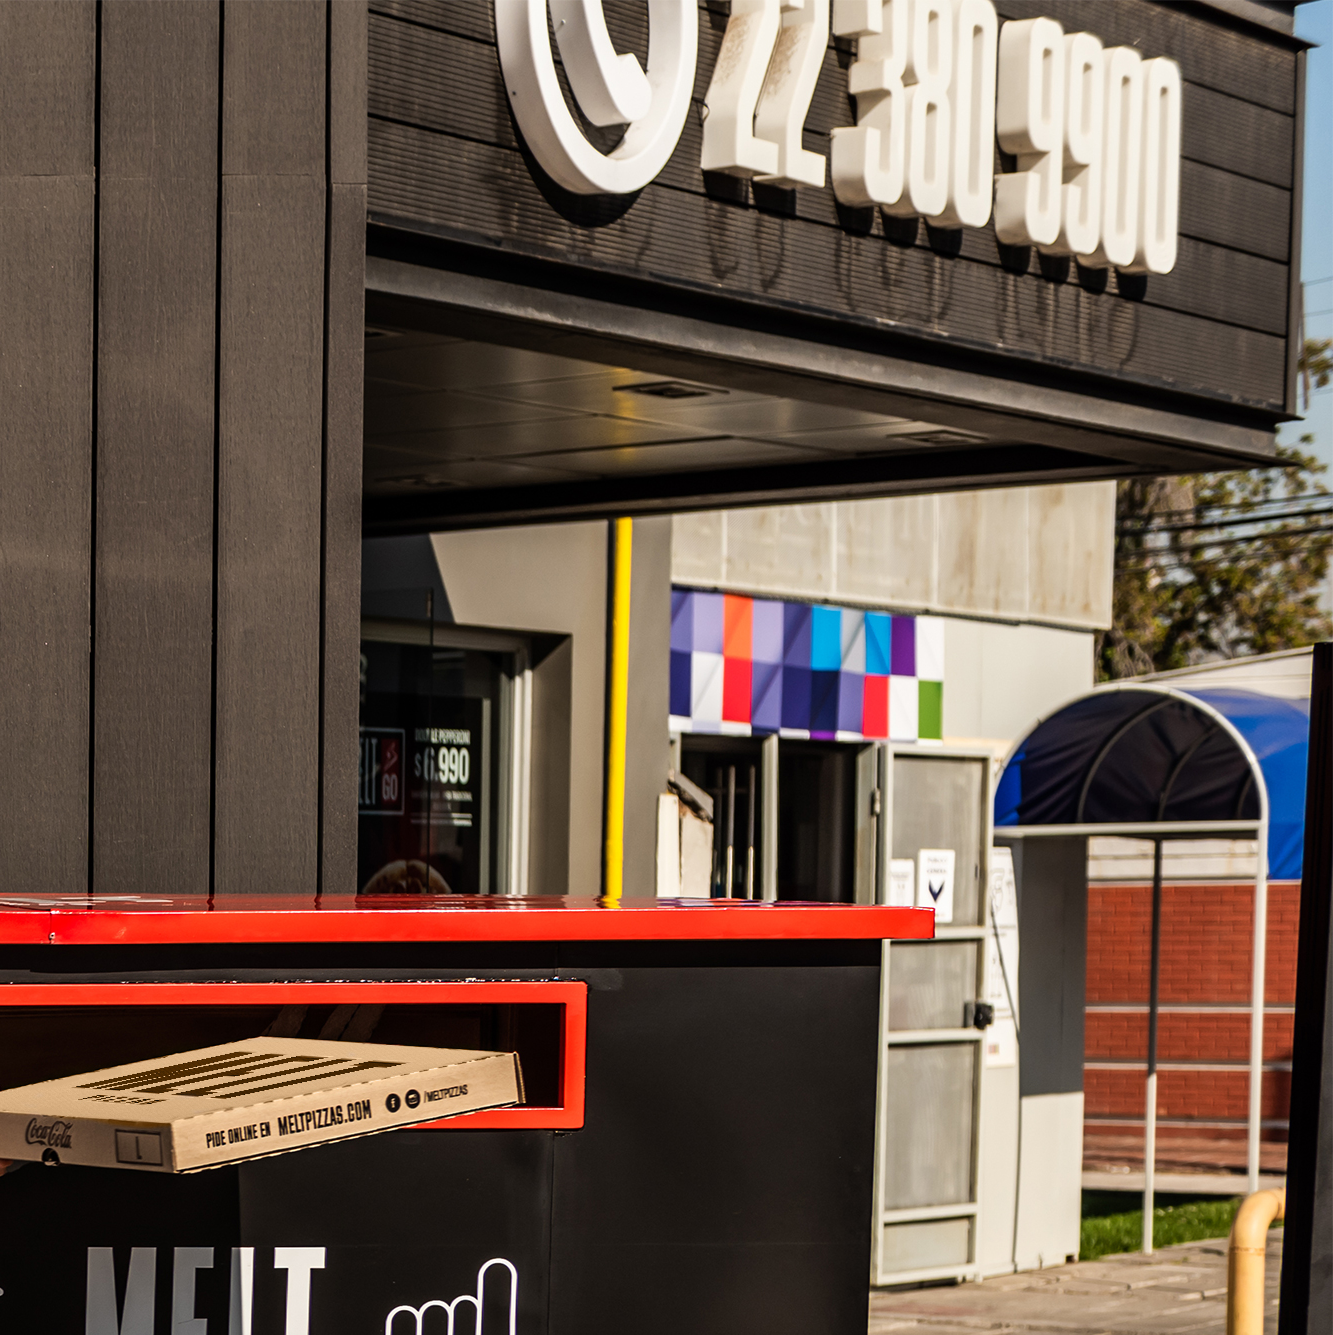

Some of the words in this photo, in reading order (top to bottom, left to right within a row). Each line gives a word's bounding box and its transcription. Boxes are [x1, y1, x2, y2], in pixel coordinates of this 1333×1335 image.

[701, 0, 827, 190] 22
[831, 0, 997, 229] 380
[995, 16, 1182, 274] 9900
[205, 1131, 227, 1149] PIDE
[228, 1123, 259, 1144] ONLINE
[260, 1121, 272, 1138] EN
[277, 1099, 373, 1137] MELTPIZZAS.COM
